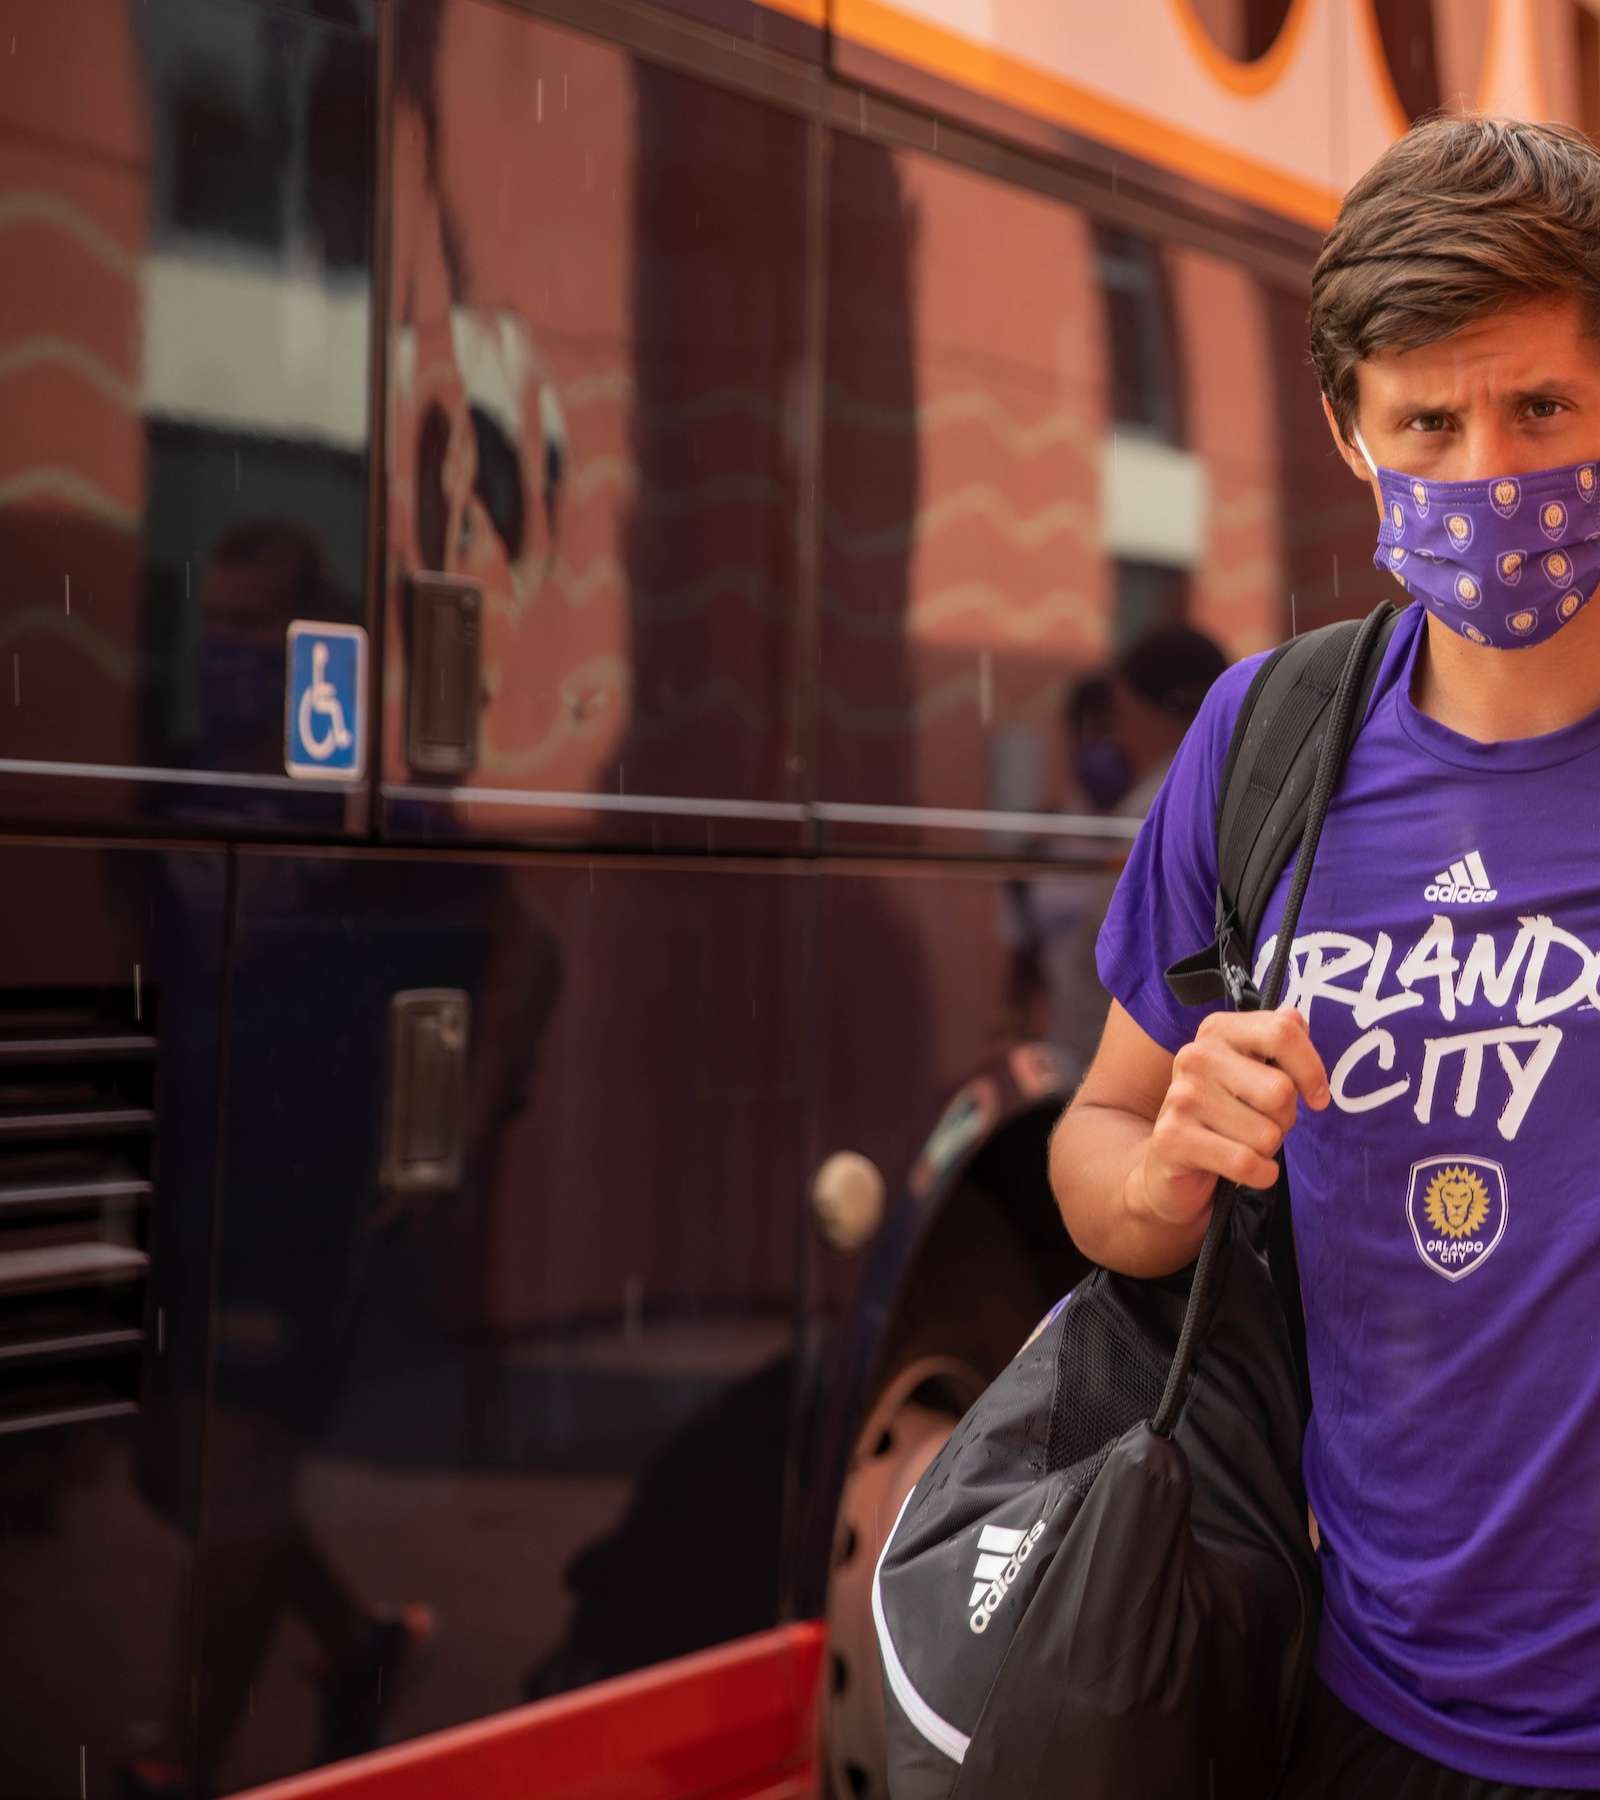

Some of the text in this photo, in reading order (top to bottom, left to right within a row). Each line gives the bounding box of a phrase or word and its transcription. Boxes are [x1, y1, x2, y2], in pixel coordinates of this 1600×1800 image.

[1424, 882, 1498, 904] adidas
[1330, 1024, 1563, 1141] CITY
[1426, 1240, 1484, 1253] ORLANDO
[1440, 1248, 1468, 1264] CITY
[969, 1519, 1047, 1635] adidas
